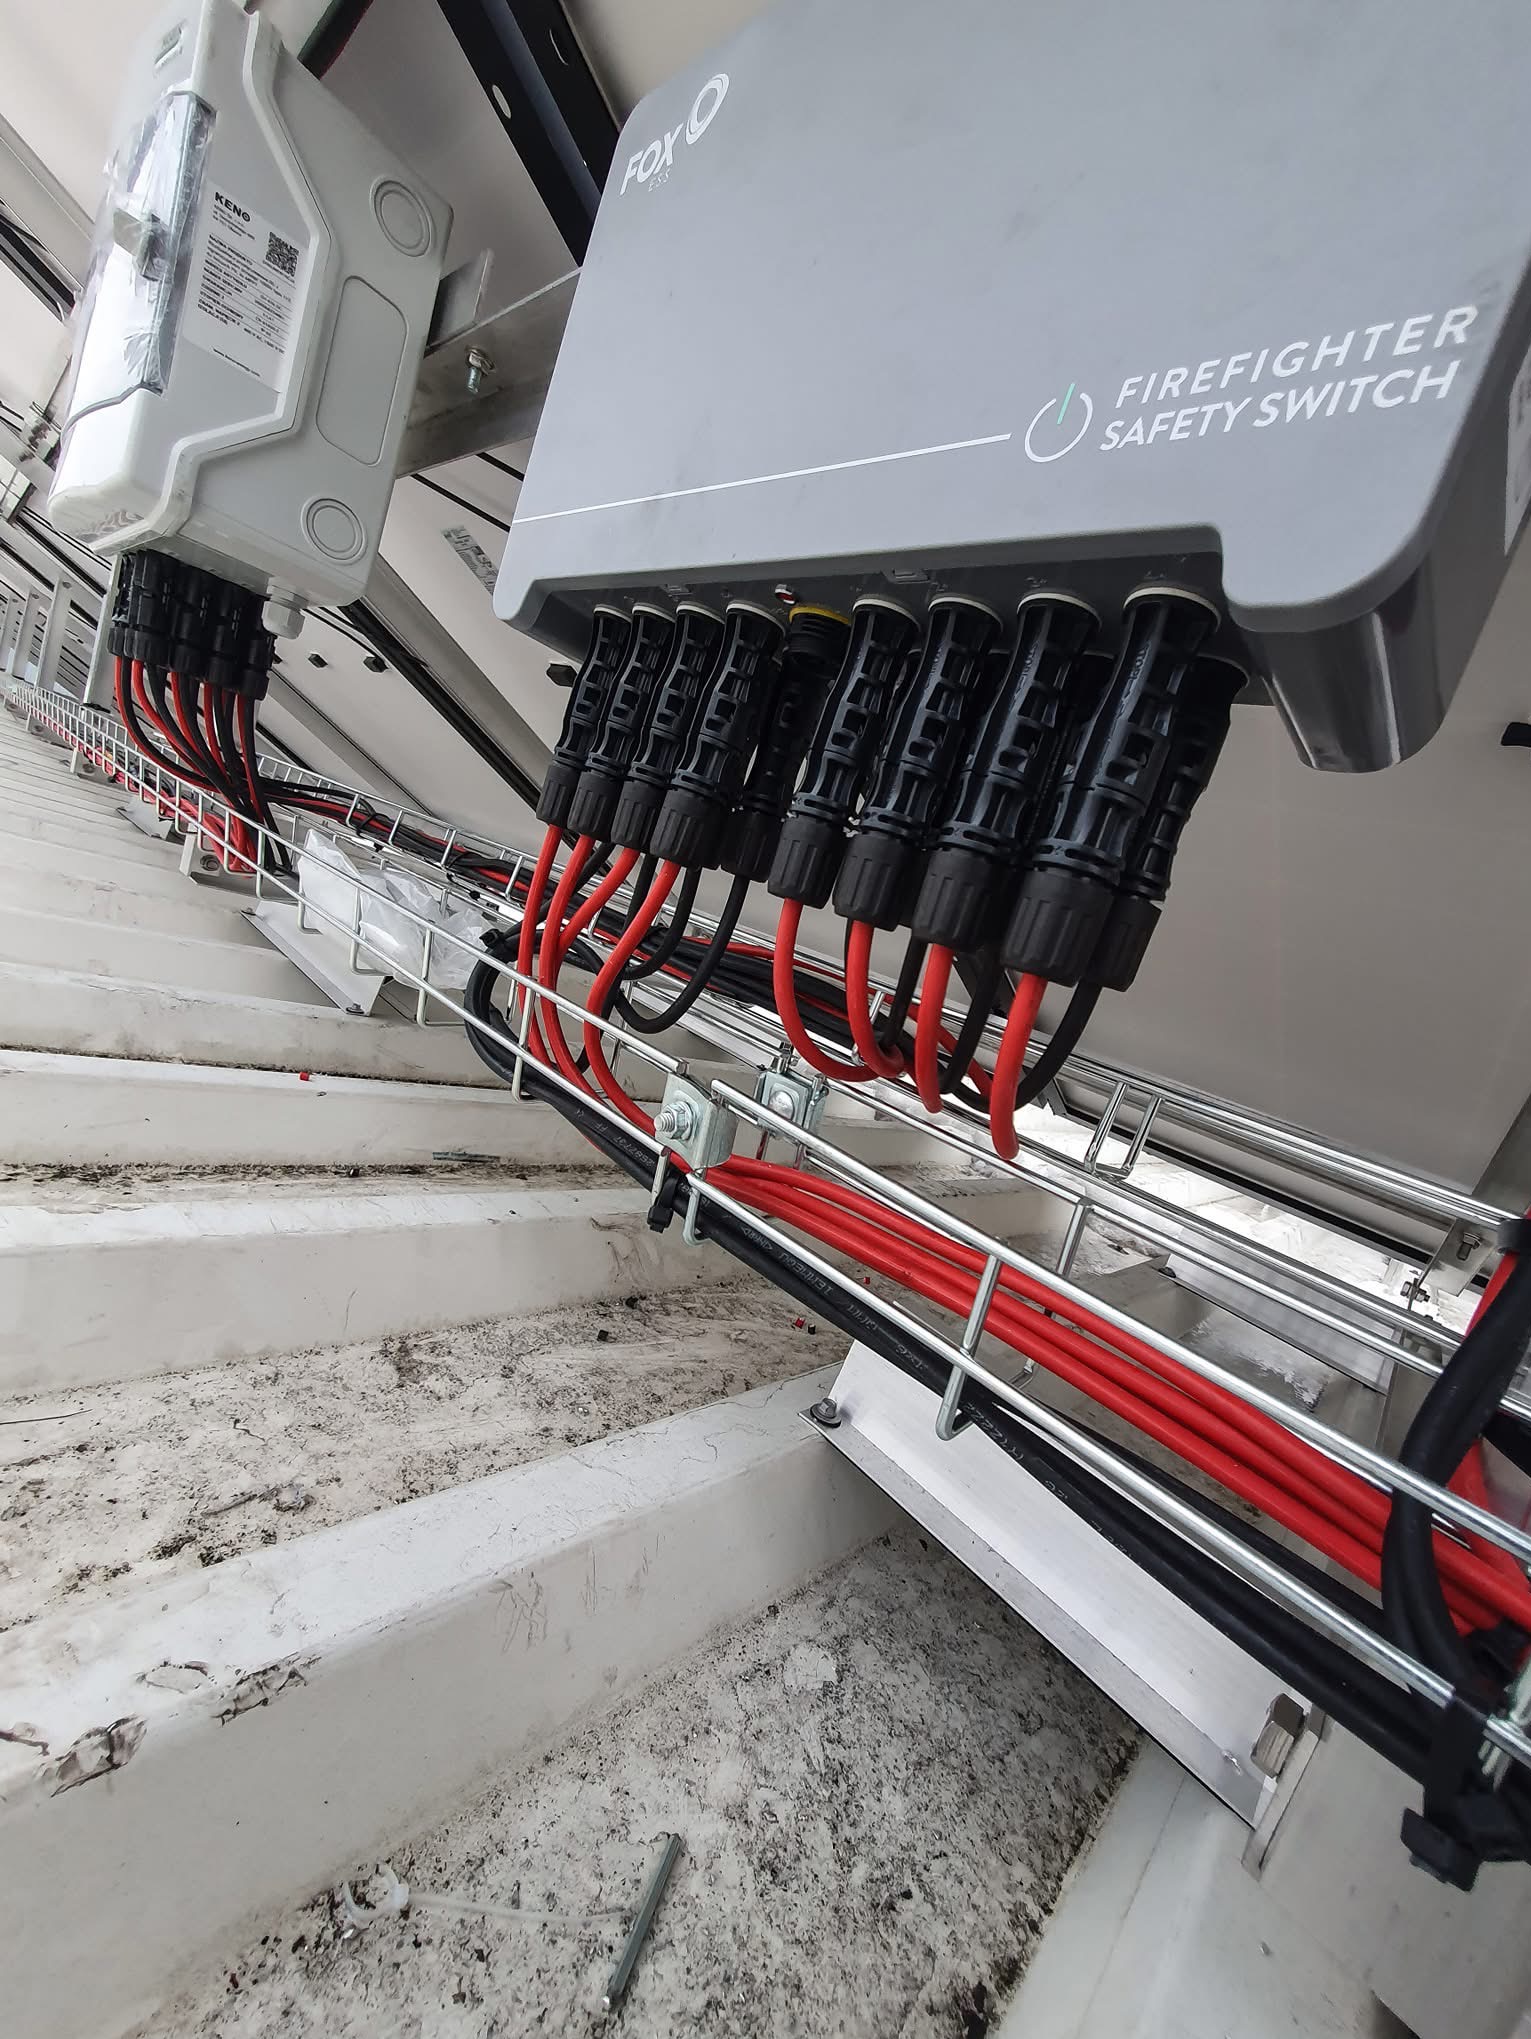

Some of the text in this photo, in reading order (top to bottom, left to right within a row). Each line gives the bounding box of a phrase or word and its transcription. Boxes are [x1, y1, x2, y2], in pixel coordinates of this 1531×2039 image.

[620, 123, 683, 194] FOX
[215, 192, 250, 221] KENO
[1116, 306, 1478, 408] FIREFIGHTER
[1100, 361, 1461, 450] SAFETY SWITCH
